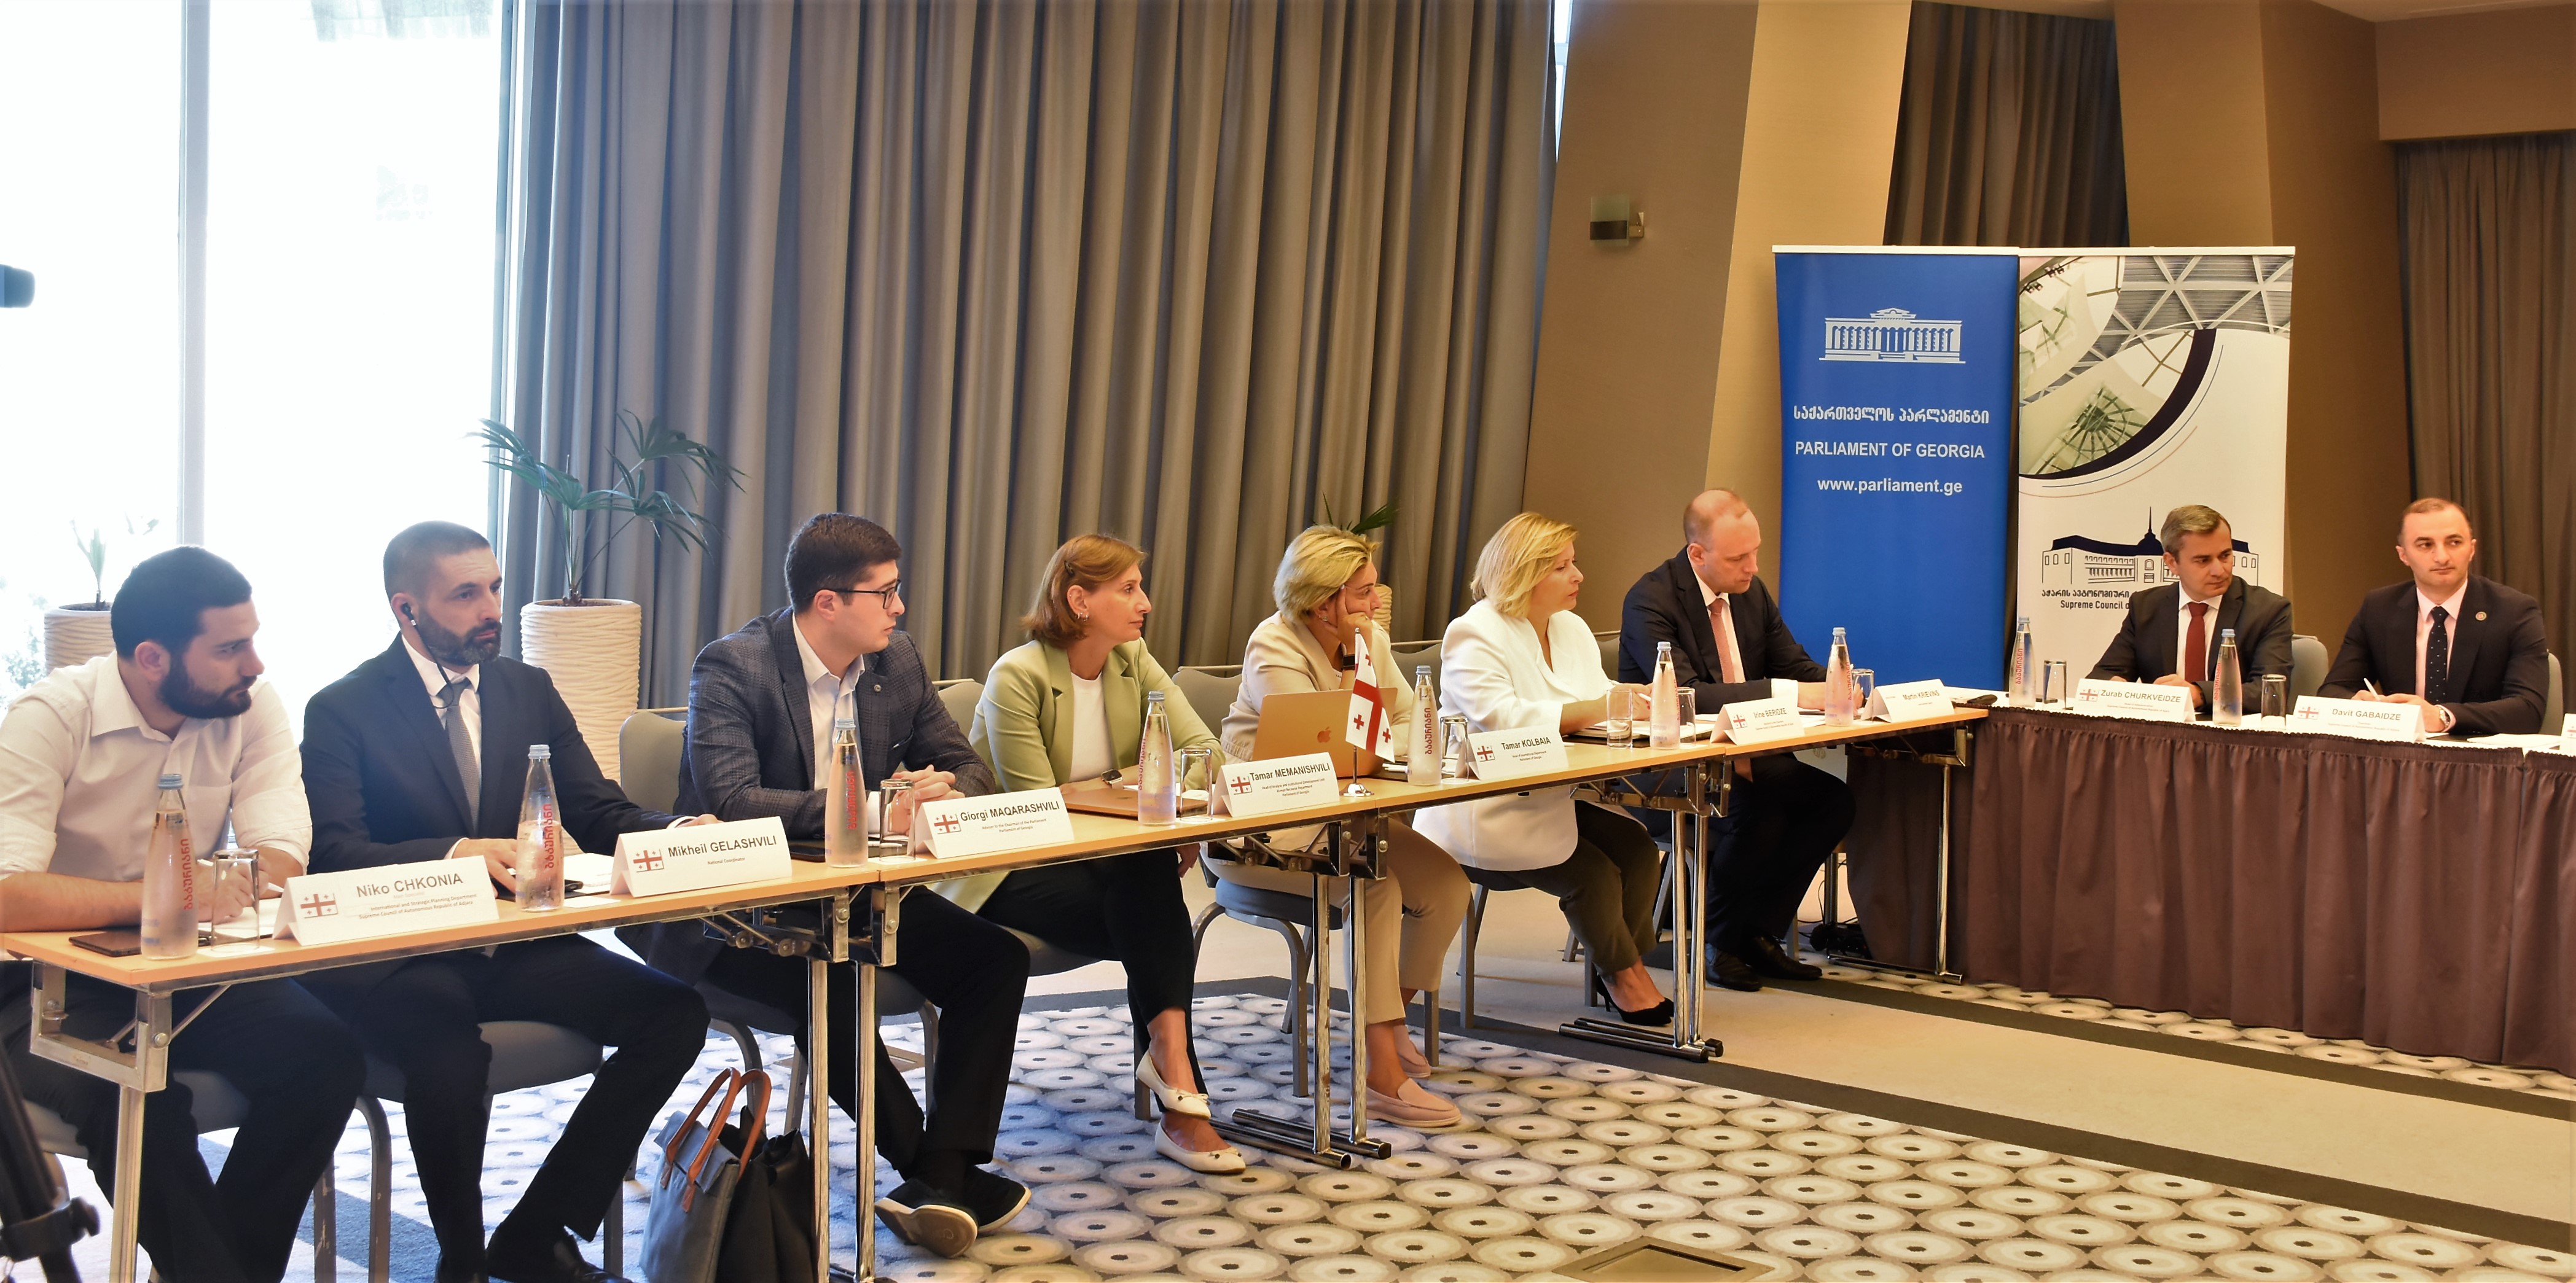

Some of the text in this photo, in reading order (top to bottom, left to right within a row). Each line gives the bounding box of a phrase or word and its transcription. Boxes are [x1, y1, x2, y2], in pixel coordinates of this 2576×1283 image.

[1793, 405, 1989, 424] საქართველოს პარლამენტი
[1795, 442, 1985, 458] PARLIAMENT OF GEORGIA
[1817, 478, 1962, 496] www.parliament.ge
[2060, 600, 2093, 609] Supreme
[2095, 601, 2123, 609] Council
[2124, 692, 2181, 703] CHURKVEIDZE
[1765, 708, 1787, 717] BERIDZE
[2332, 708, 2401, 720] Davit GABAIDZE
[1521, 736, 1551, 747] KOLBAIA
[1250, 763, 1330, 782] Tamar MEMANISHVILI
[960, 801, 1060, 821] Giorgi MAQARASHVILI
[542, 803, 554, 868] ბაკურიანი
[668, 835, 777, 857] Mikheil GELASHVILI
[180, 838, 193, 910] ბაკურიანი
[356, 873, 463, 897] Niko CHKONIA
